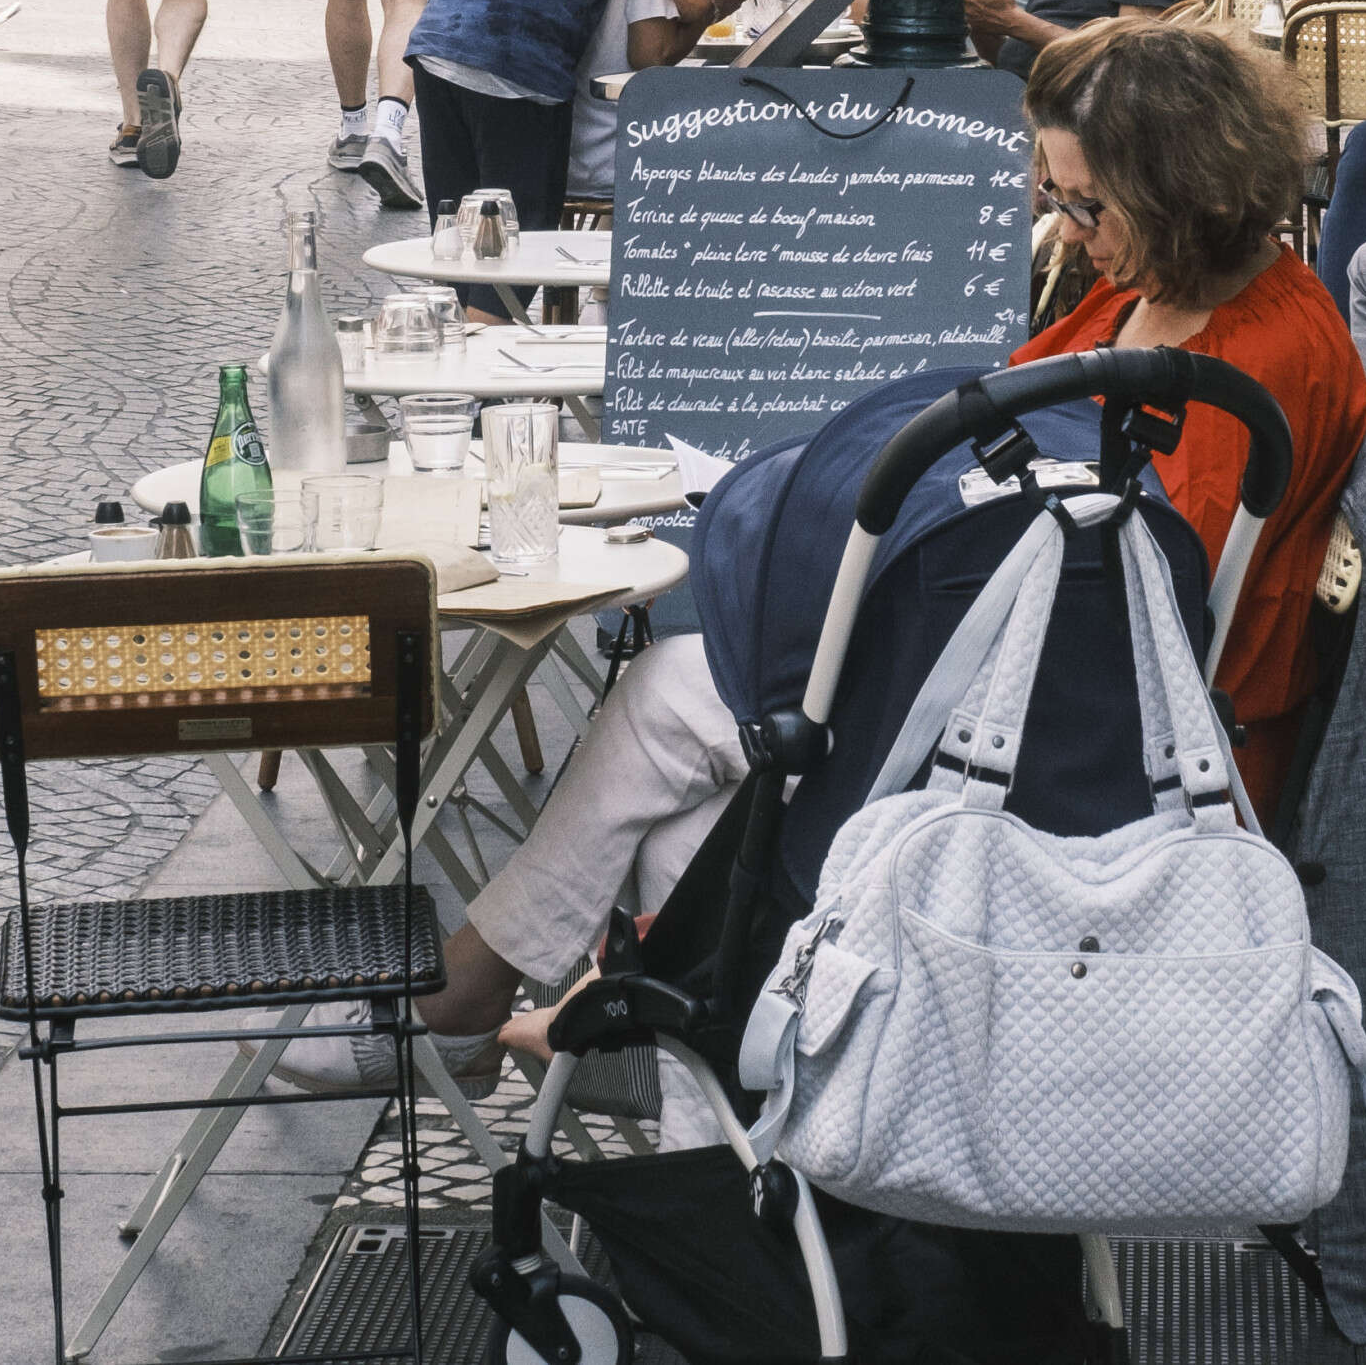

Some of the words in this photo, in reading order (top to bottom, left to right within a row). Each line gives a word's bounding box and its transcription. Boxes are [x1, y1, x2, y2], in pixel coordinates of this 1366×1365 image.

[627, 98, 823, 147] Suggestions
[828, 93, 880, 122] du
[886, 105, 1029, 152] moment
[631, 156, 691, 195] Asperges
[697, 159, 756, 183] blanches
[761, 165, 785, 183] des
[788, 162, 839, 185] Landes
[839, 166, 899, 196] jambon
[899, 174, 975, 192] parmesan
[627, 196, 675, 224] Terrine
[680, 204, 697, 224] de
[701, 212, 743, 232] queue
[749, 206, 767, 224] de
[816, 206, 876, 227] maison
[624, 234, 678, 260] Tomates
[779, 249, 828, 263] mousse
[832, 245, 849, 264] de
[852, 245, 898, 263] chevre
[621, 273, 670, 298] Rillette
[674, 277, 692, 298] de
[694, 277, 734, 300] truite
[738, 278, 754, 299] et
[757, 282, 815, 299] rascasse
[820, 288, 838, 299] au
[842, 279, 884, 299] citron
[887, 278, 918, 298] vert
[671, 328, 687, 347] de
[692, 334, 724, 348] veau
[811, 328, 861, 349] basilic
[648, 359, 663, 379] de
[666, 367, 744, 388] maquereaux
[748, 368, 764, 380] au
[767, 363, 787, 382] vin
[790, 362, 831, 381] blanc
[834, 361, 886, 382] salade
[647, 392, 665, 412] de
[667, 395, 724, 413] daurade
[741, 391, 759, 412] la
[611, 419, 648, 436] SATE
[603, 999, 628, 1017] YOYO
